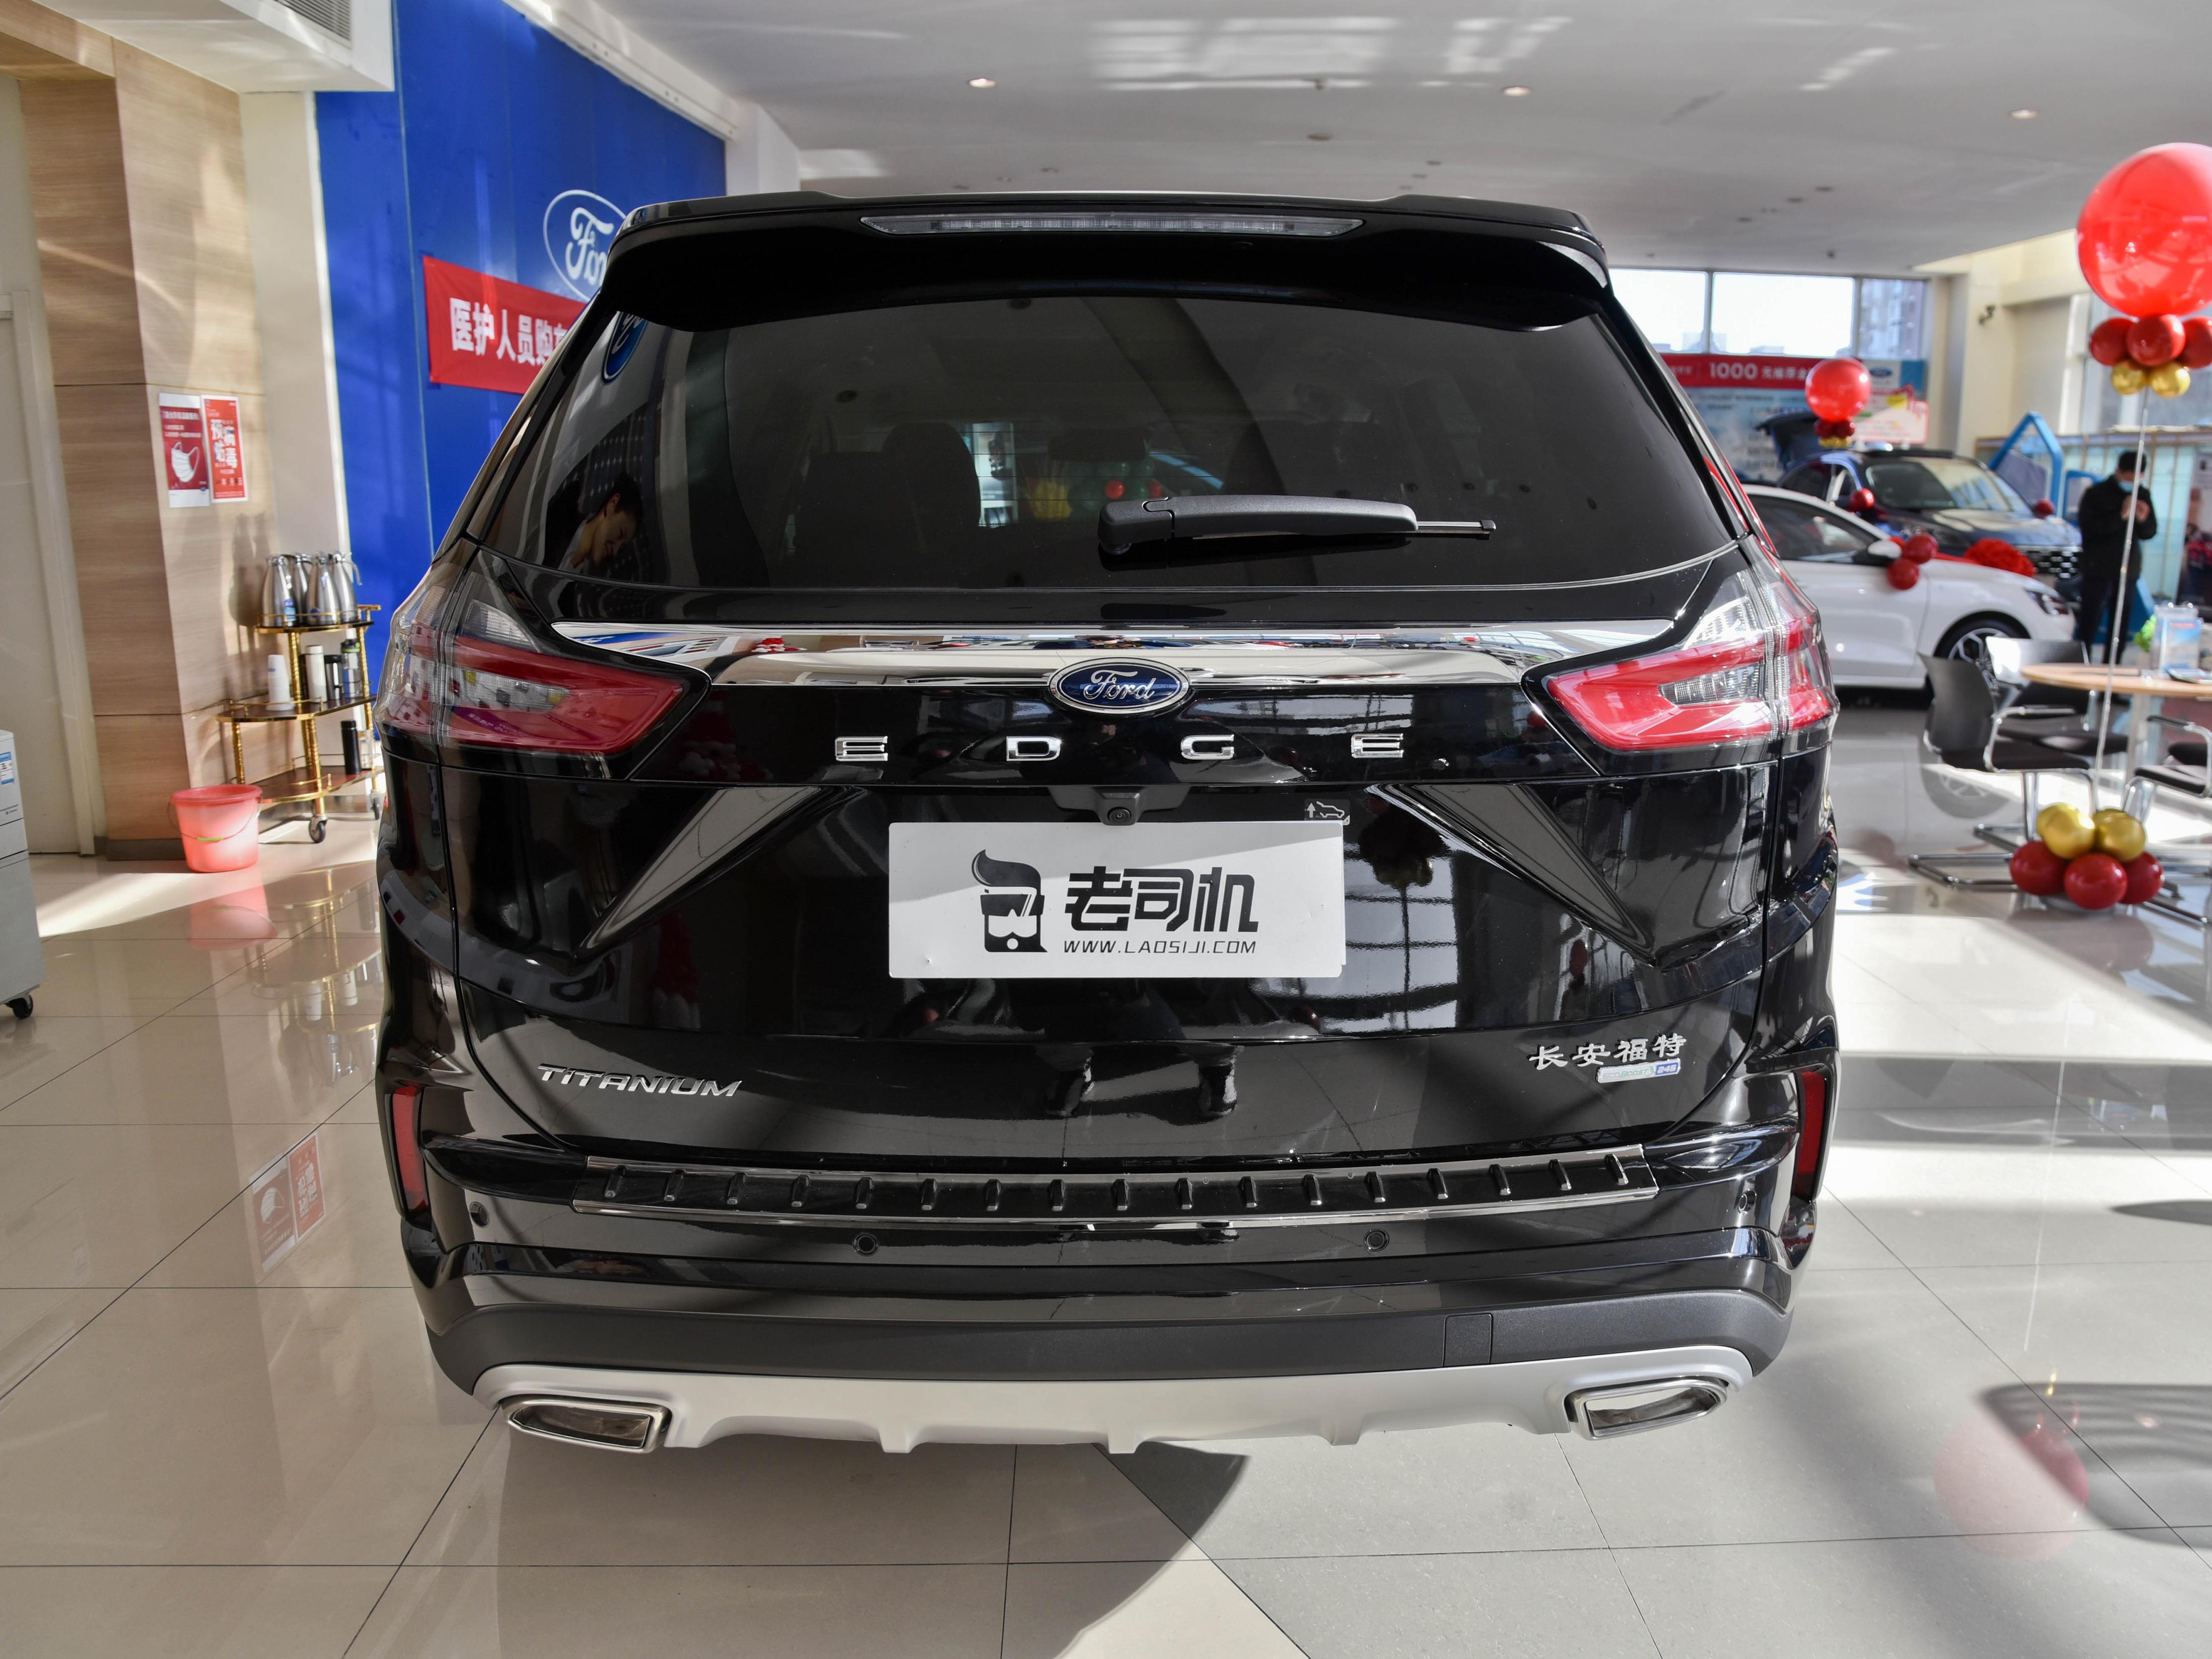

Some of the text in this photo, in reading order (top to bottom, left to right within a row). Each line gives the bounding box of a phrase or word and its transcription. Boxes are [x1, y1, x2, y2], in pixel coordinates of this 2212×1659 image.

[565, 207, 614, 287] Fo
[1710, 361, 1758, 380] 1000
[1083, 670, 1157, 700] Ford
[835, 733, 1404, 762] EDGE
[1064, 866, 1259, 933] 老司机
[1064, 940, 1257, 954] WWW.LAOSIJI.COM
[1529, 1033, 1687, 1070] 长安福特
[537, 1063, 743, 1097] TITANIUM
[1656, 1064, 1677, 1074] 245
